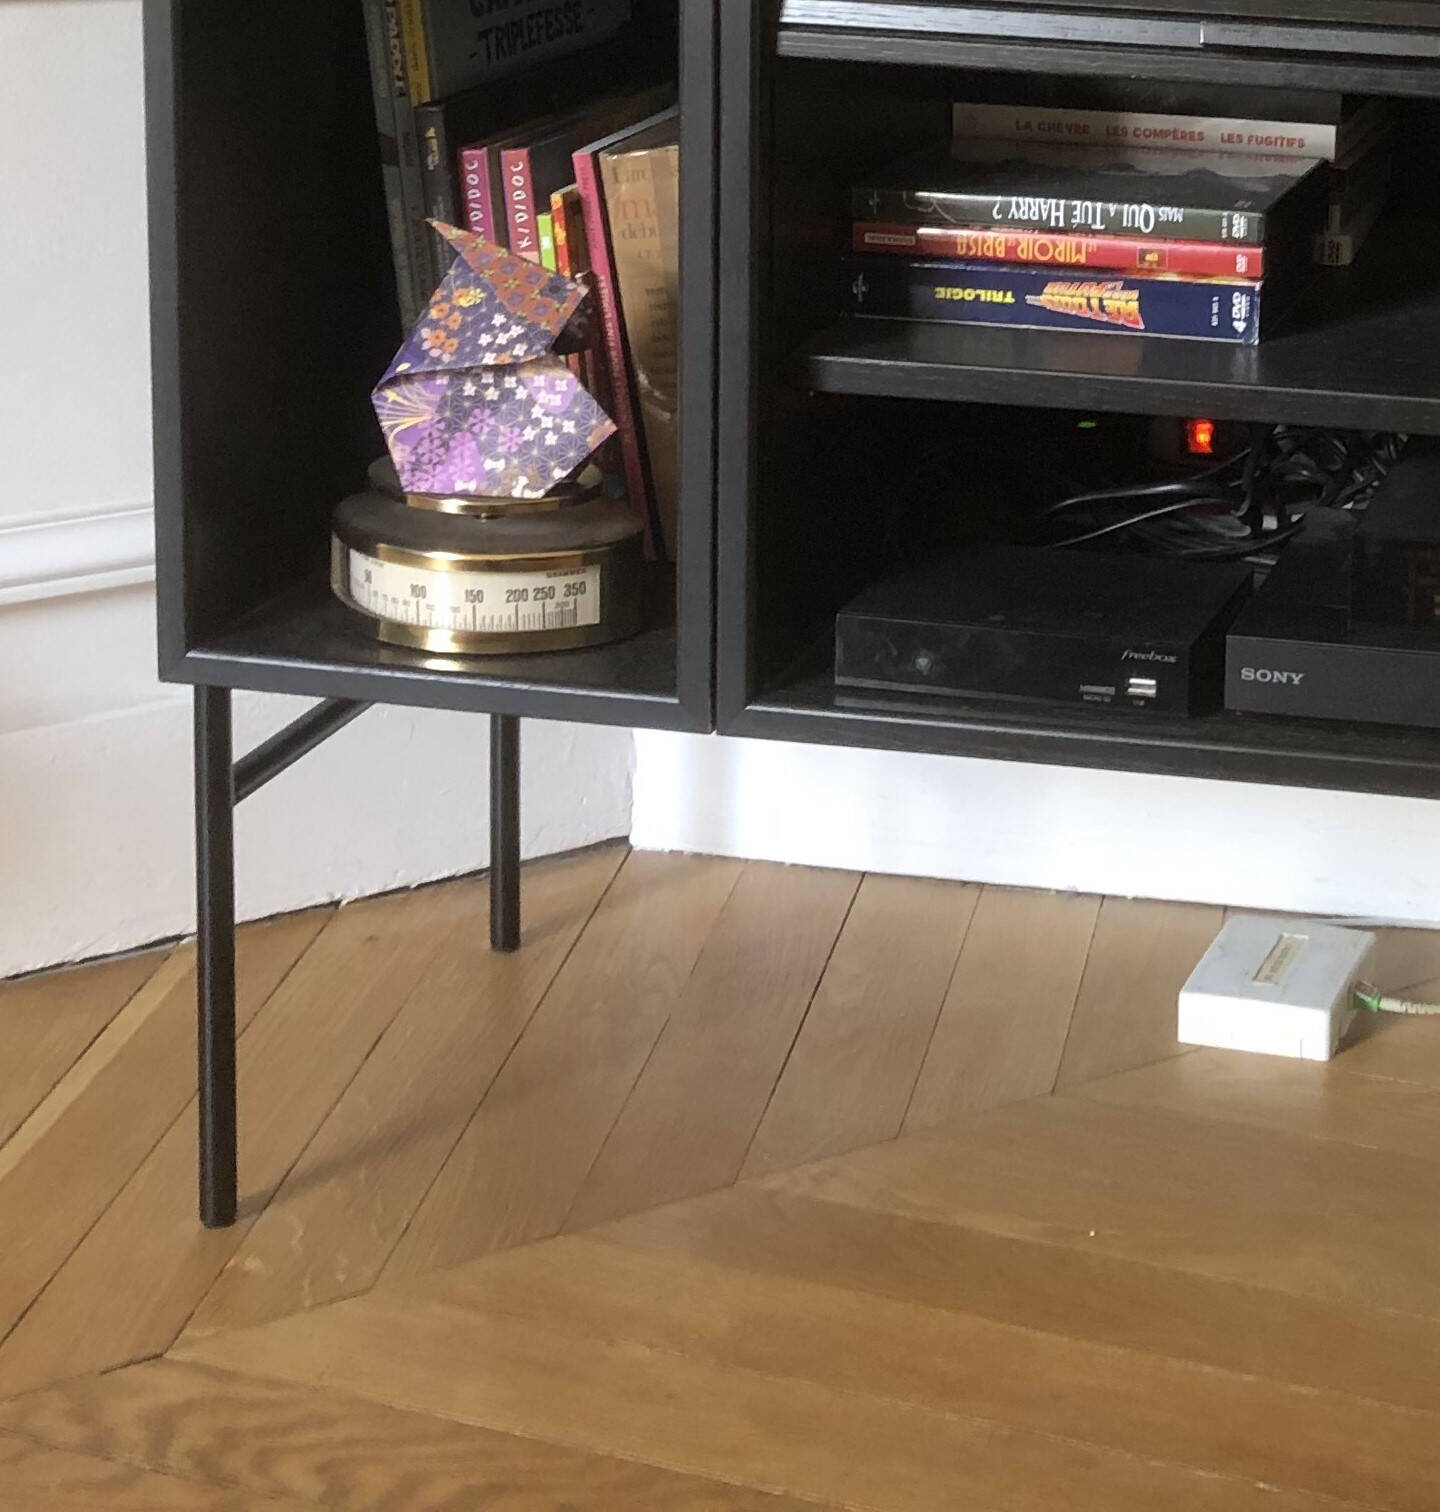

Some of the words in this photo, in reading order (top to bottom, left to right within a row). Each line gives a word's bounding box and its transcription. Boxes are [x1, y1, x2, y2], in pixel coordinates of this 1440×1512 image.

[1015, 119, 1033, 133] LA
[1104, 124, 1128, 138] LES
[1220, 130, 1245, 145] LES
[1247, 132, 1307, 150] FUGITIFS
[465, 158, 485, 234] IDIDOC
[510, 160, 532, 249] KIDIDOC
[992, 199, 1003, 224] ?
[1006, 196, 1065, 223] HARRY
[1071, 199, 1107, 229] TUÉ
[1108, 202, 1118, 217] A
[1122, 202, 1156, 233] QUI
[1156, 205, 1183, 224] MAIS
[956, 234, 1006, 258] BRISA
[1016, 237, 1087, 265] MIROIR
[934, 286, 1016, 305] TRILOGIE
[1039, 294, 1146, 330] RETOUR
[1232, 320, 1247, 334] 4
[409, 583, 428, 600] 100
[464, 588, 484, 604] 150
[505, 588, 529, 603] 200
[533, 585, 556, 602] 250
[563, 580, 587, 597] 350
[1120, 648, 1179, 664] freebox
[1239, 666, 1305, 686] SONY
